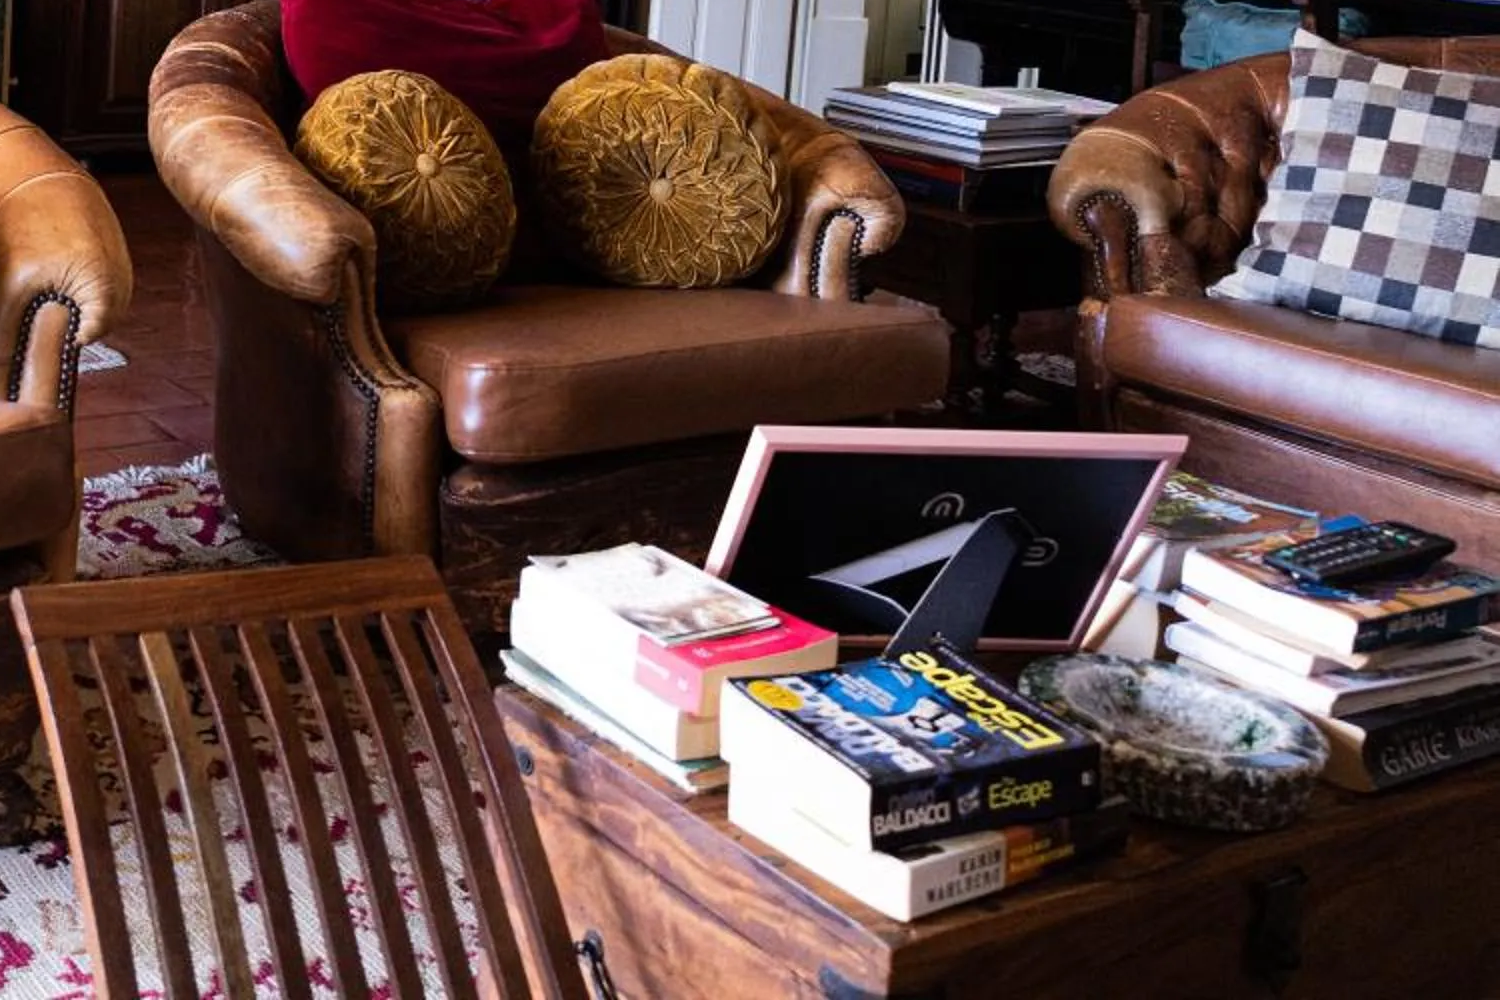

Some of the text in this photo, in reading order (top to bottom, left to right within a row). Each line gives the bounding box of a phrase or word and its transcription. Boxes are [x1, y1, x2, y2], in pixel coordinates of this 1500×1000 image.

[900, 650, 1065, 750] Escape
[988, 779, 1054, 809] Escape
[872, 801, 950, 836] BALDACCI
[958, 847, 1002, 876] KARIN
[926, 867, 1002, 904] WAHLBERG
